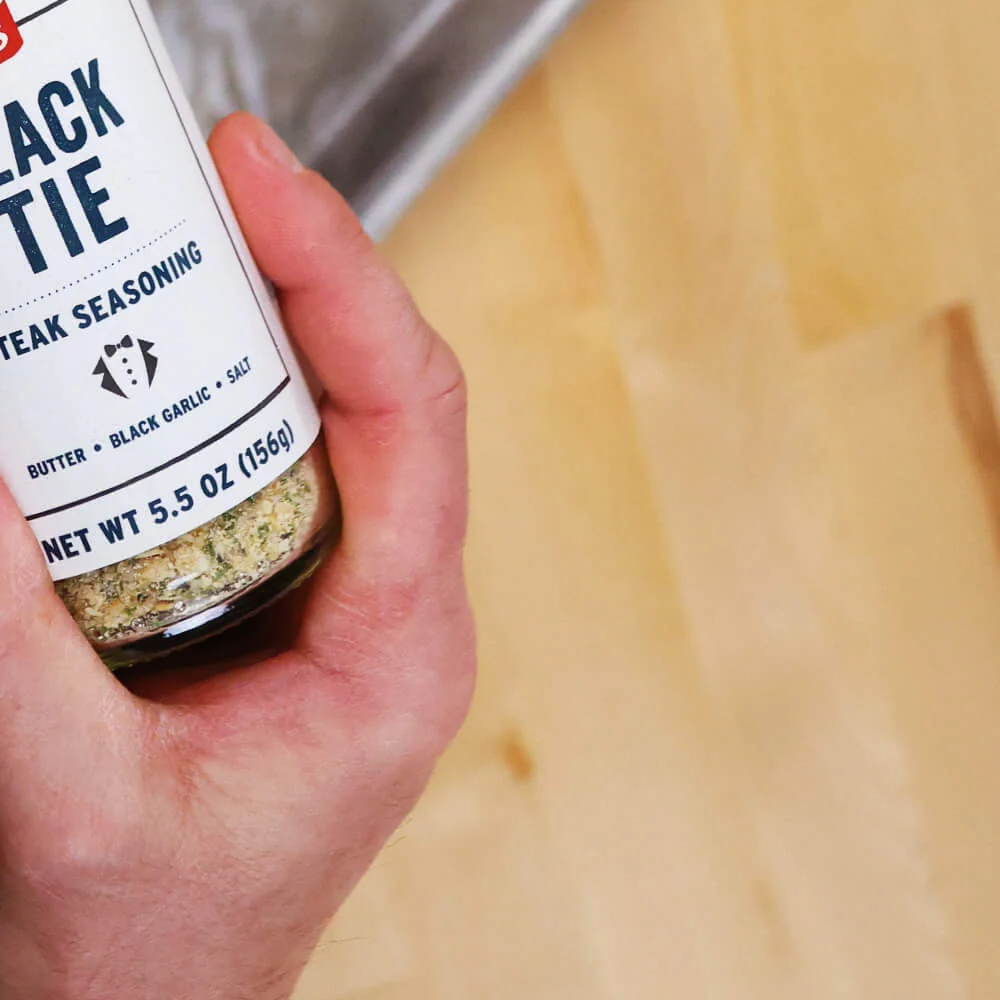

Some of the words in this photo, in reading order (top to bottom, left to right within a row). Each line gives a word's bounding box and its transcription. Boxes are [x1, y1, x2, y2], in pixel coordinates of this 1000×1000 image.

[72, 240, 203, 330] SEASONING
[27, 447, 87, 479] BUTTER
[109, 415, 160, 449] BLACK
[162, 385, 212, 424] GARLIC
[226, 356, 251, 384] SALT
[41, 527, 93, 563] NET
[98, 509, 140, 545] WT
[148, 485, 195, 525] 5.5
[200, 463, 235, 499] OZ
[238, 418, 296, 479] (156g)
